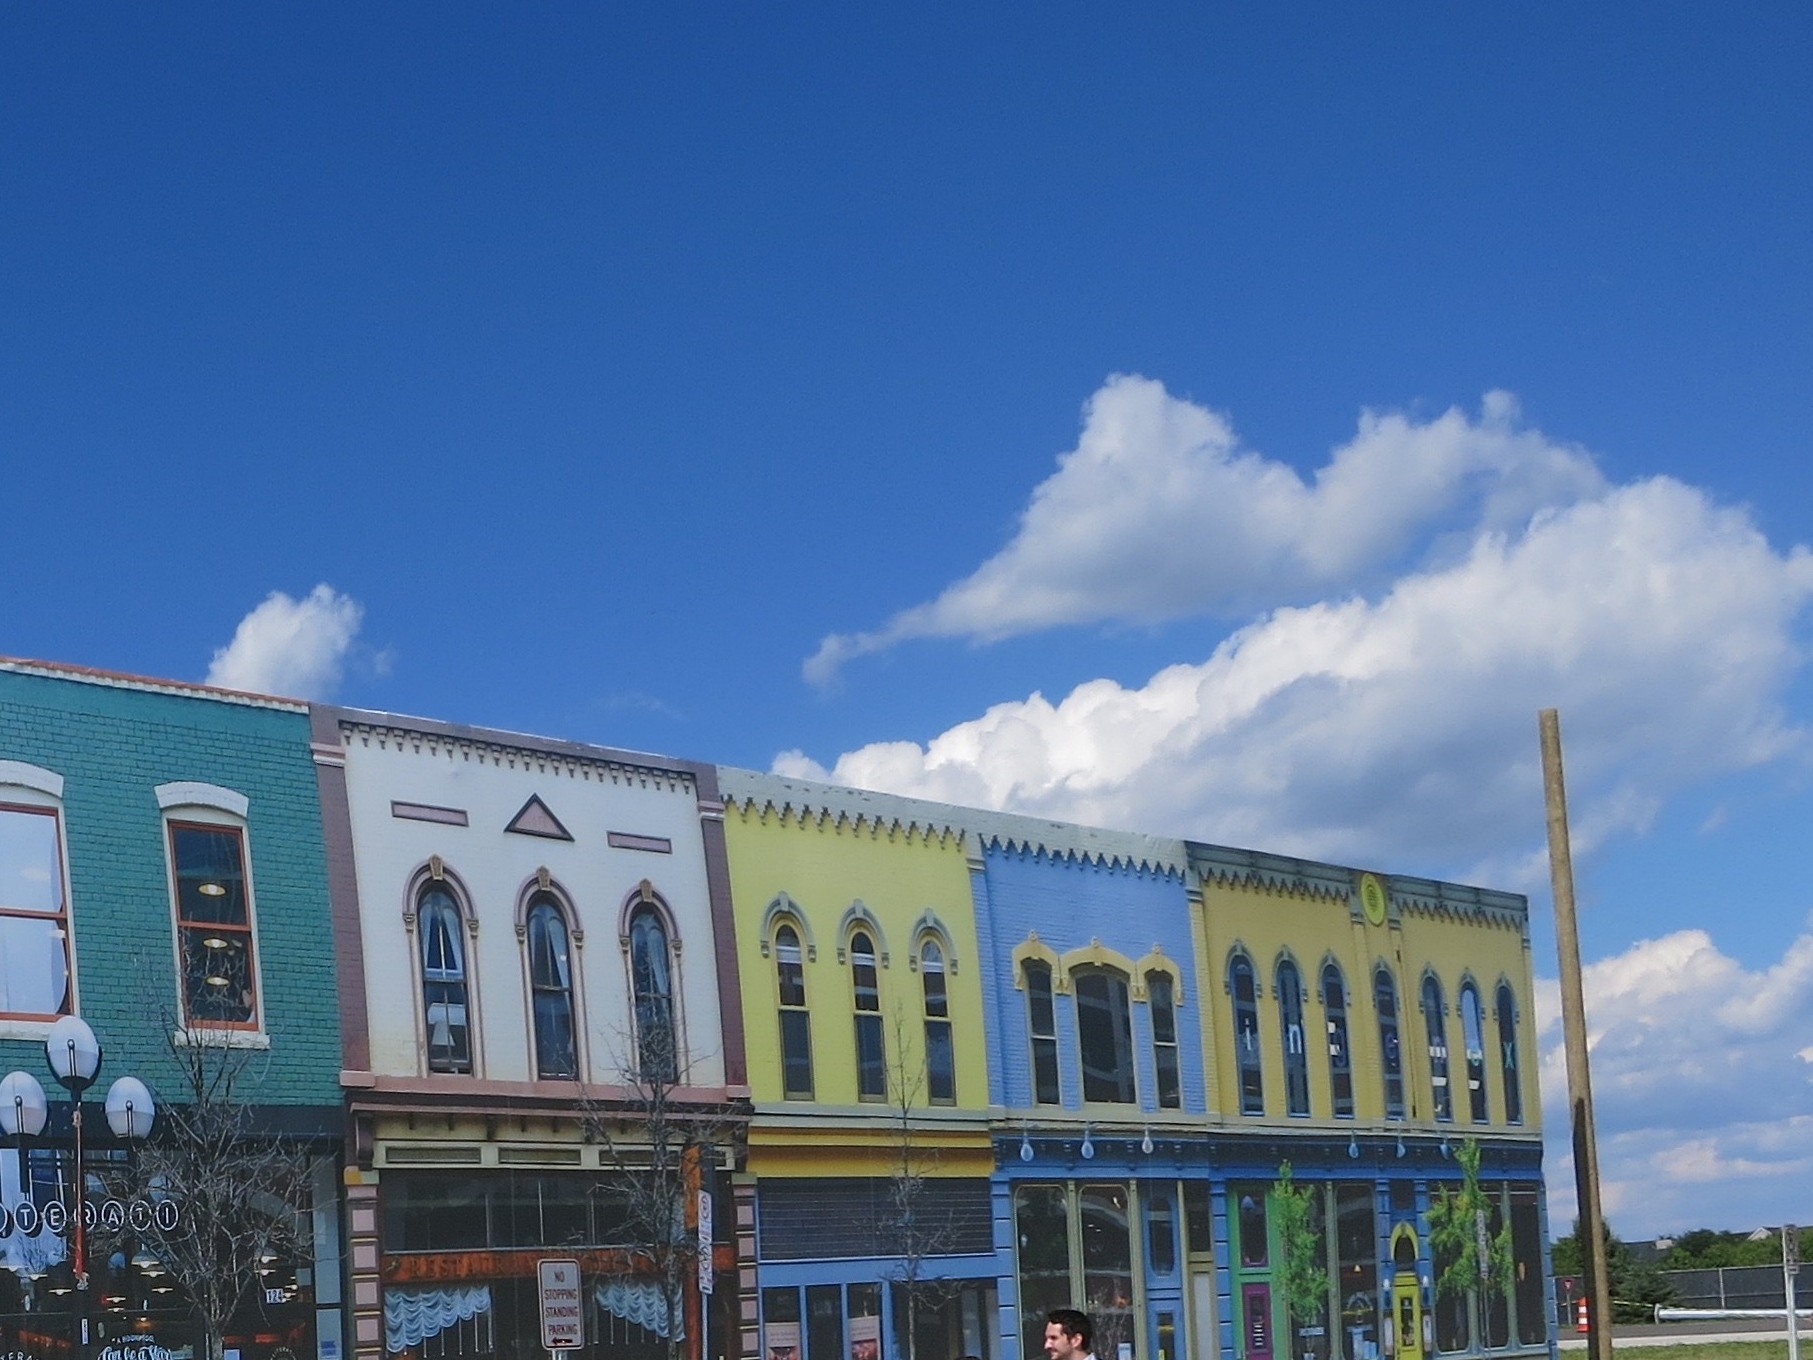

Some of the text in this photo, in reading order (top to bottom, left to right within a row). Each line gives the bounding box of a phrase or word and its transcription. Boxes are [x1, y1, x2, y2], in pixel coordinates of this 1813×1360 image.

[410, 1252, 539, 1278] RESTAURAN
[553, 1271, 566, 1283] NO
[267, 1289, 283, 1303] 124
[544, 1288, 578, 1301] STOPPING
[545, 1306, 579, 1318] STANDING
[548, 1323, 578, 1335] PARKING
